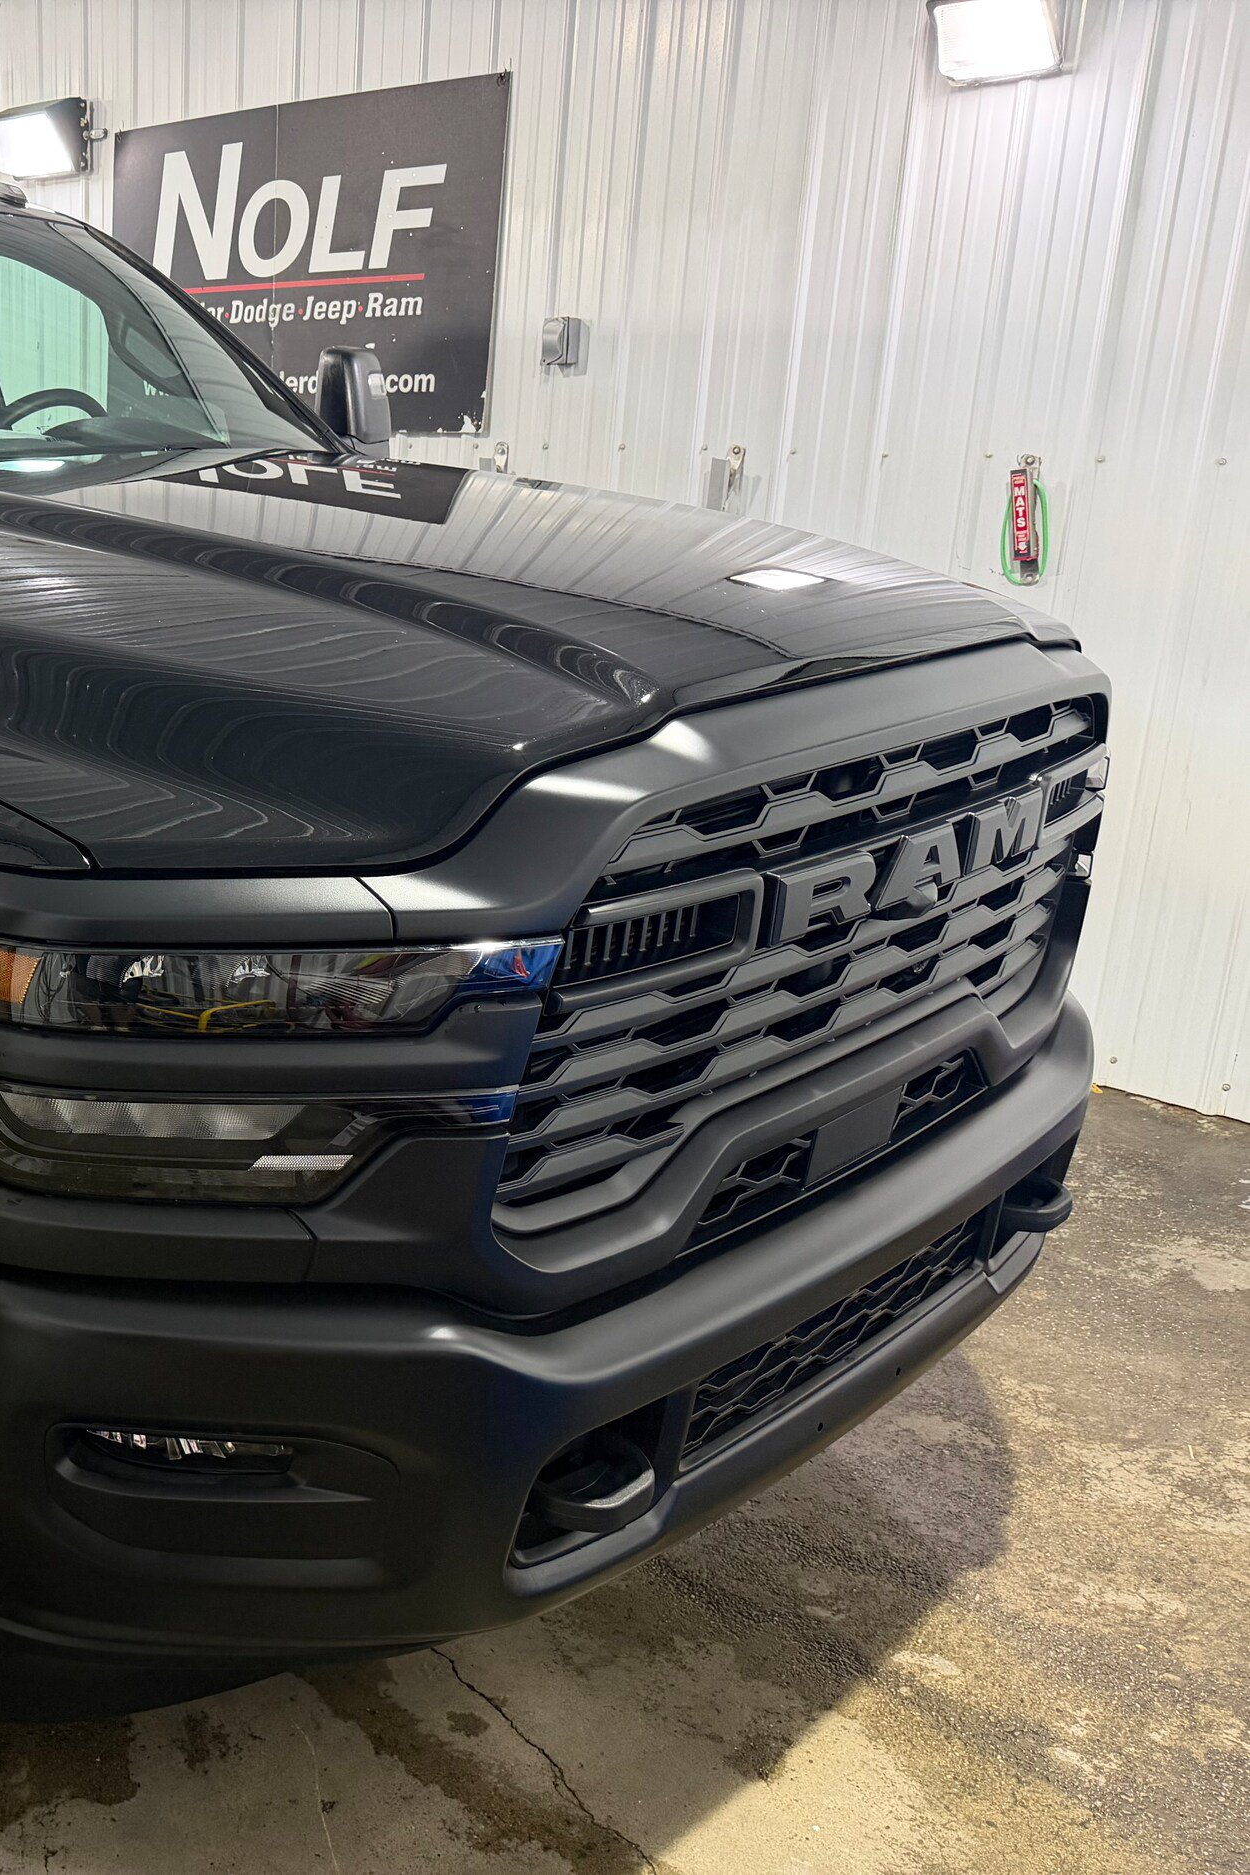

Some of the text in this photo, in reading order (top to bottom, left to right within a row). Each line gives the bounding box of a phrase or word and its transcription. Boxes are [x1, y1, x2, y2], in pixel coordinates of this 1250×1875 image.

[152, 141, 448, 281] NOLF
[230, 299, 295, 327] Dodge
[302, 296, 356, 325] Jeep
[365, 293, 423, 318] Ram
[1014, 485, 1027, 528] MATS
[768, 785, 1043, 947] RAM
